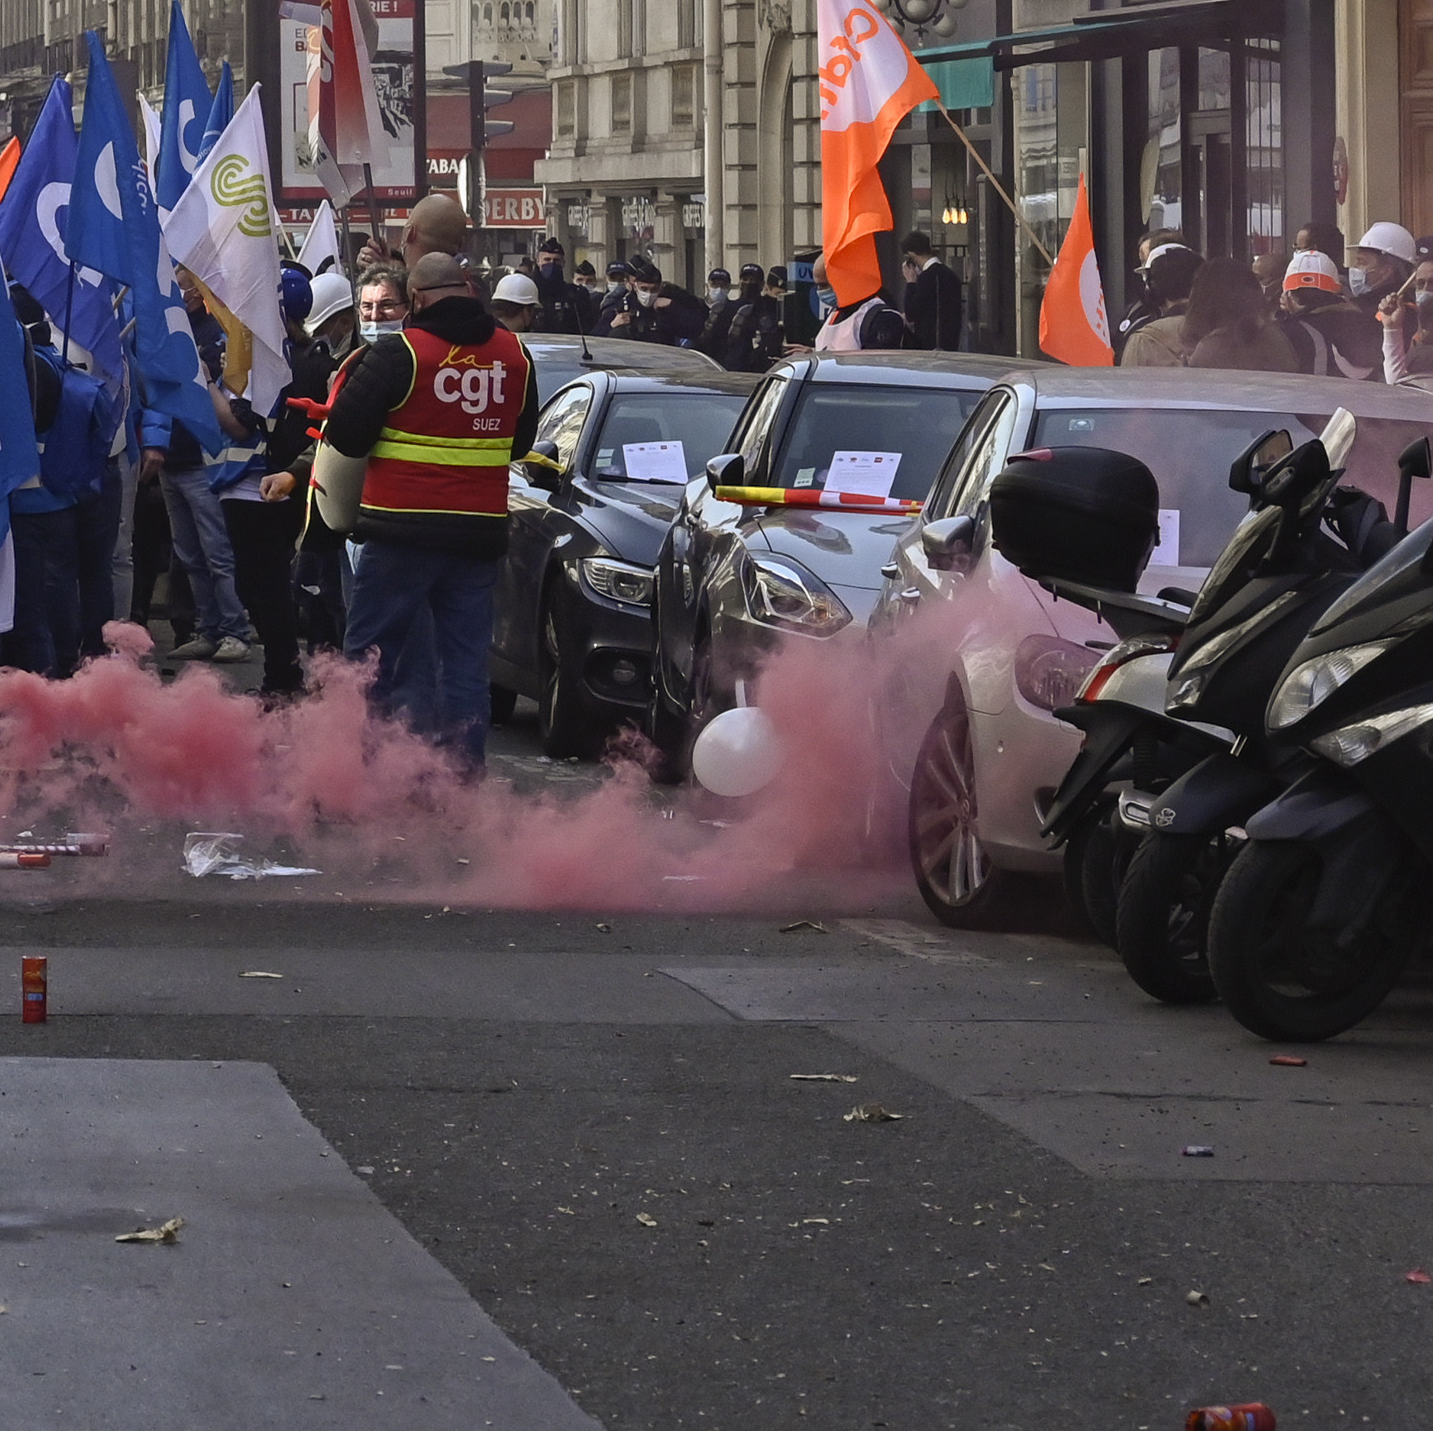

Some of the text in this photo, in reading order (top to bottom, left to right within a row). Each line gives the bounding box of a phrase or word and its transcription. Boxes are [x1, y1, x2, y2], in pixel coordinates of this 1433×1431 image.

[387, 187, 413, 196] Seuil
[433, 360, 507, 415] cgt
[472, 418, 501, 431] SUEZ
